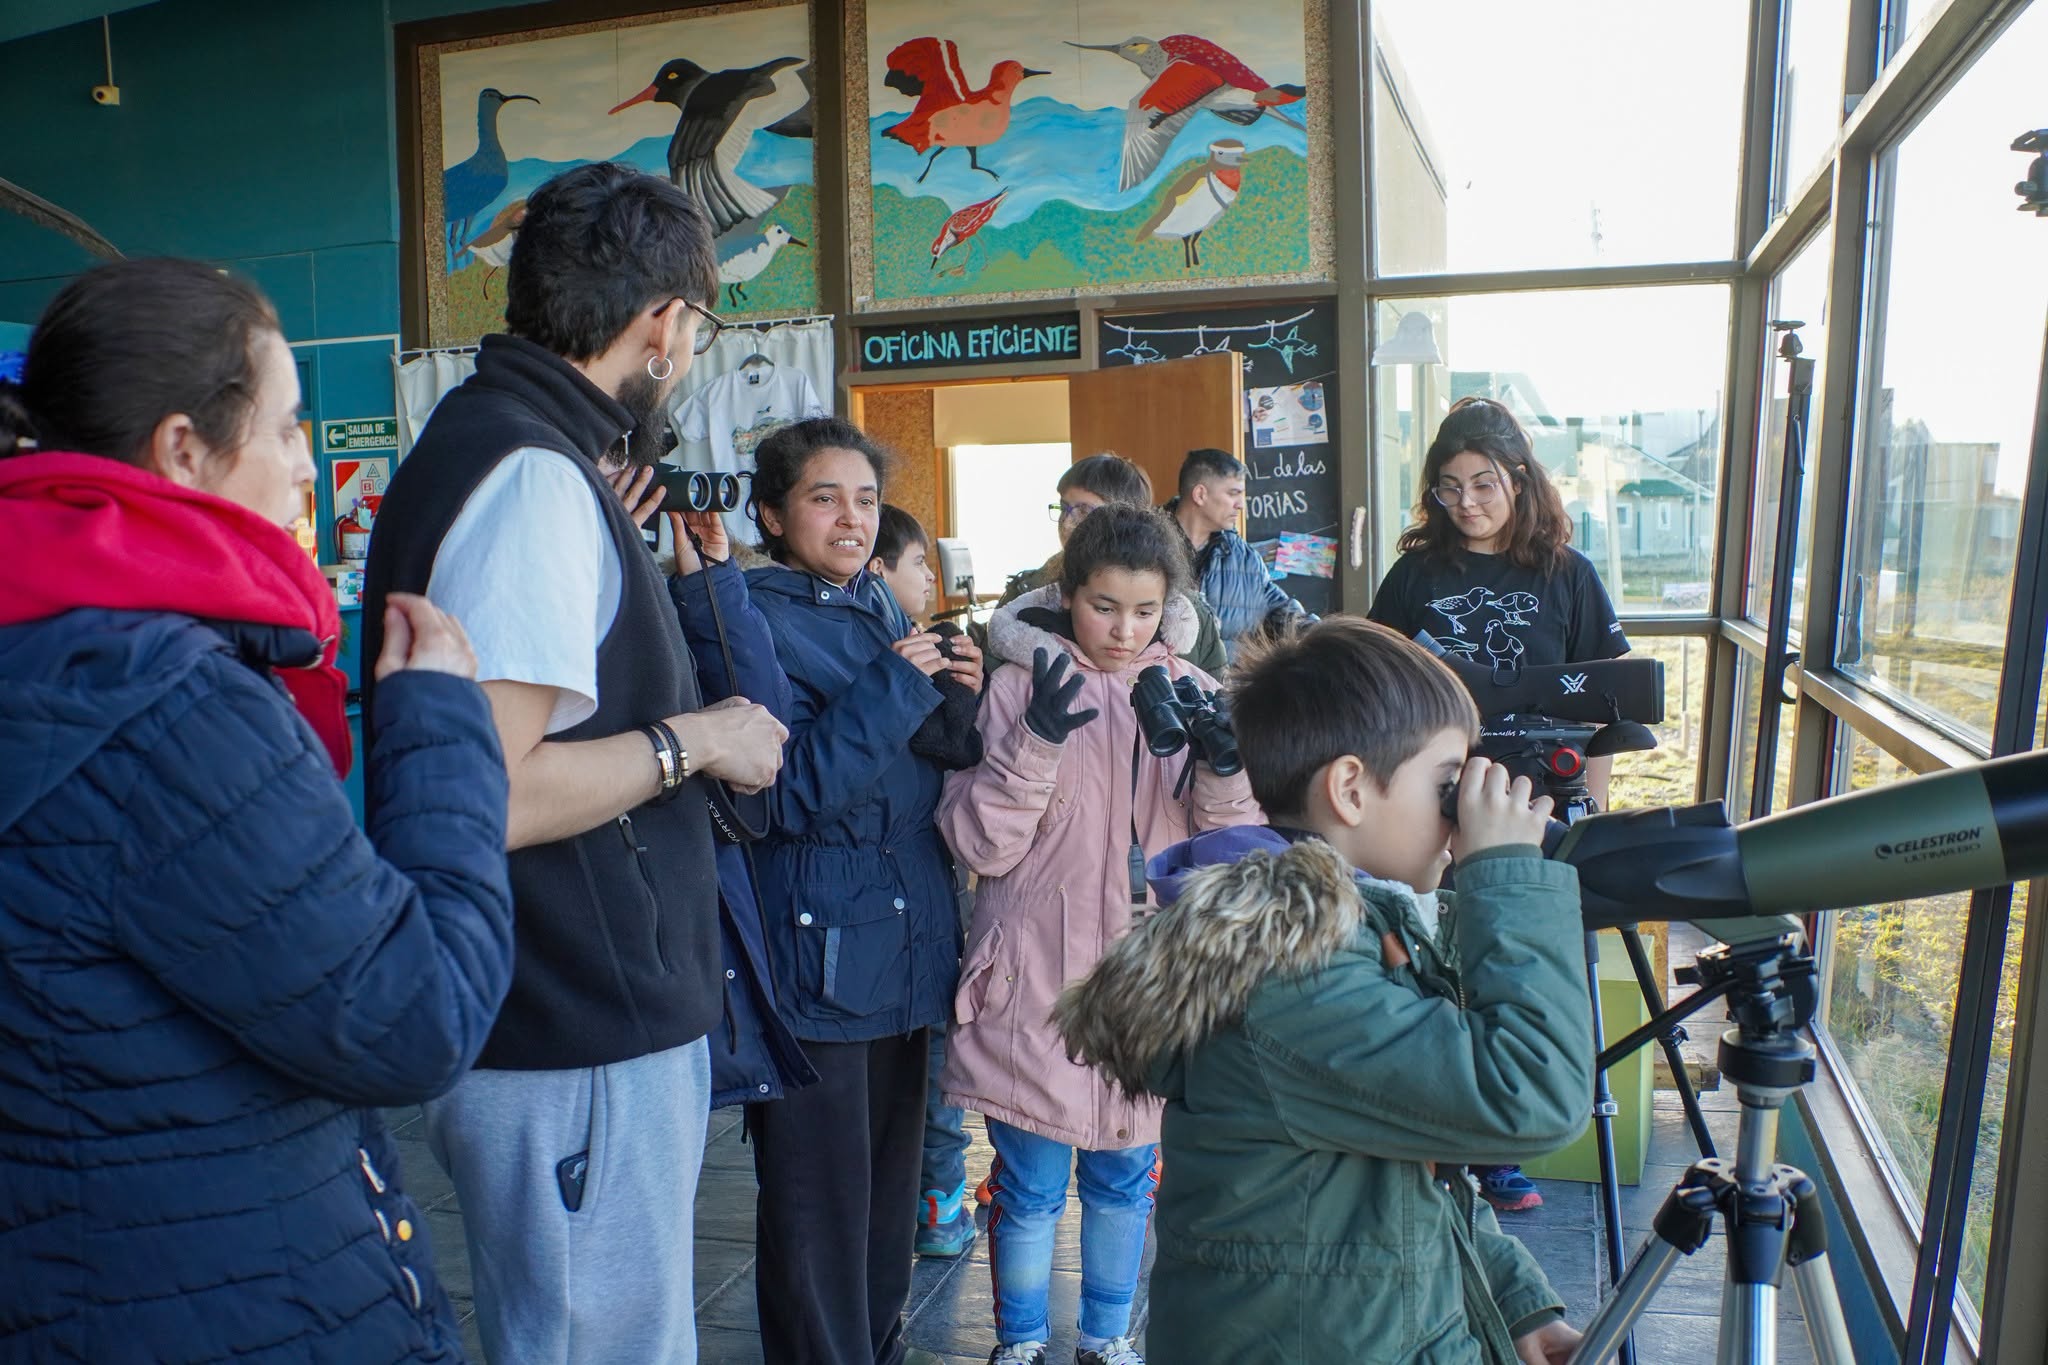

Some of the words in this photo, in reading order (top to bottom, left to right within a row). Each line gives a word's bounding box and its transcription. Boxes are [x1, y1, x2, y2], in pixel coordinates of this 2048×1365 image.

[864, 330, 961, 364] OFICINA
[968, 324, 1078, 358] EFICIENTE
[347, 423, 374, 436] SALIDA
[375, 422, 385, 434] DE
[348, 435, 398, 449] EMERGENCIA
[1273, 452, 1294, 477] de
[1295, 450, 1327, 477] las
[1894, 826, 1981, 854] CELESTRON
